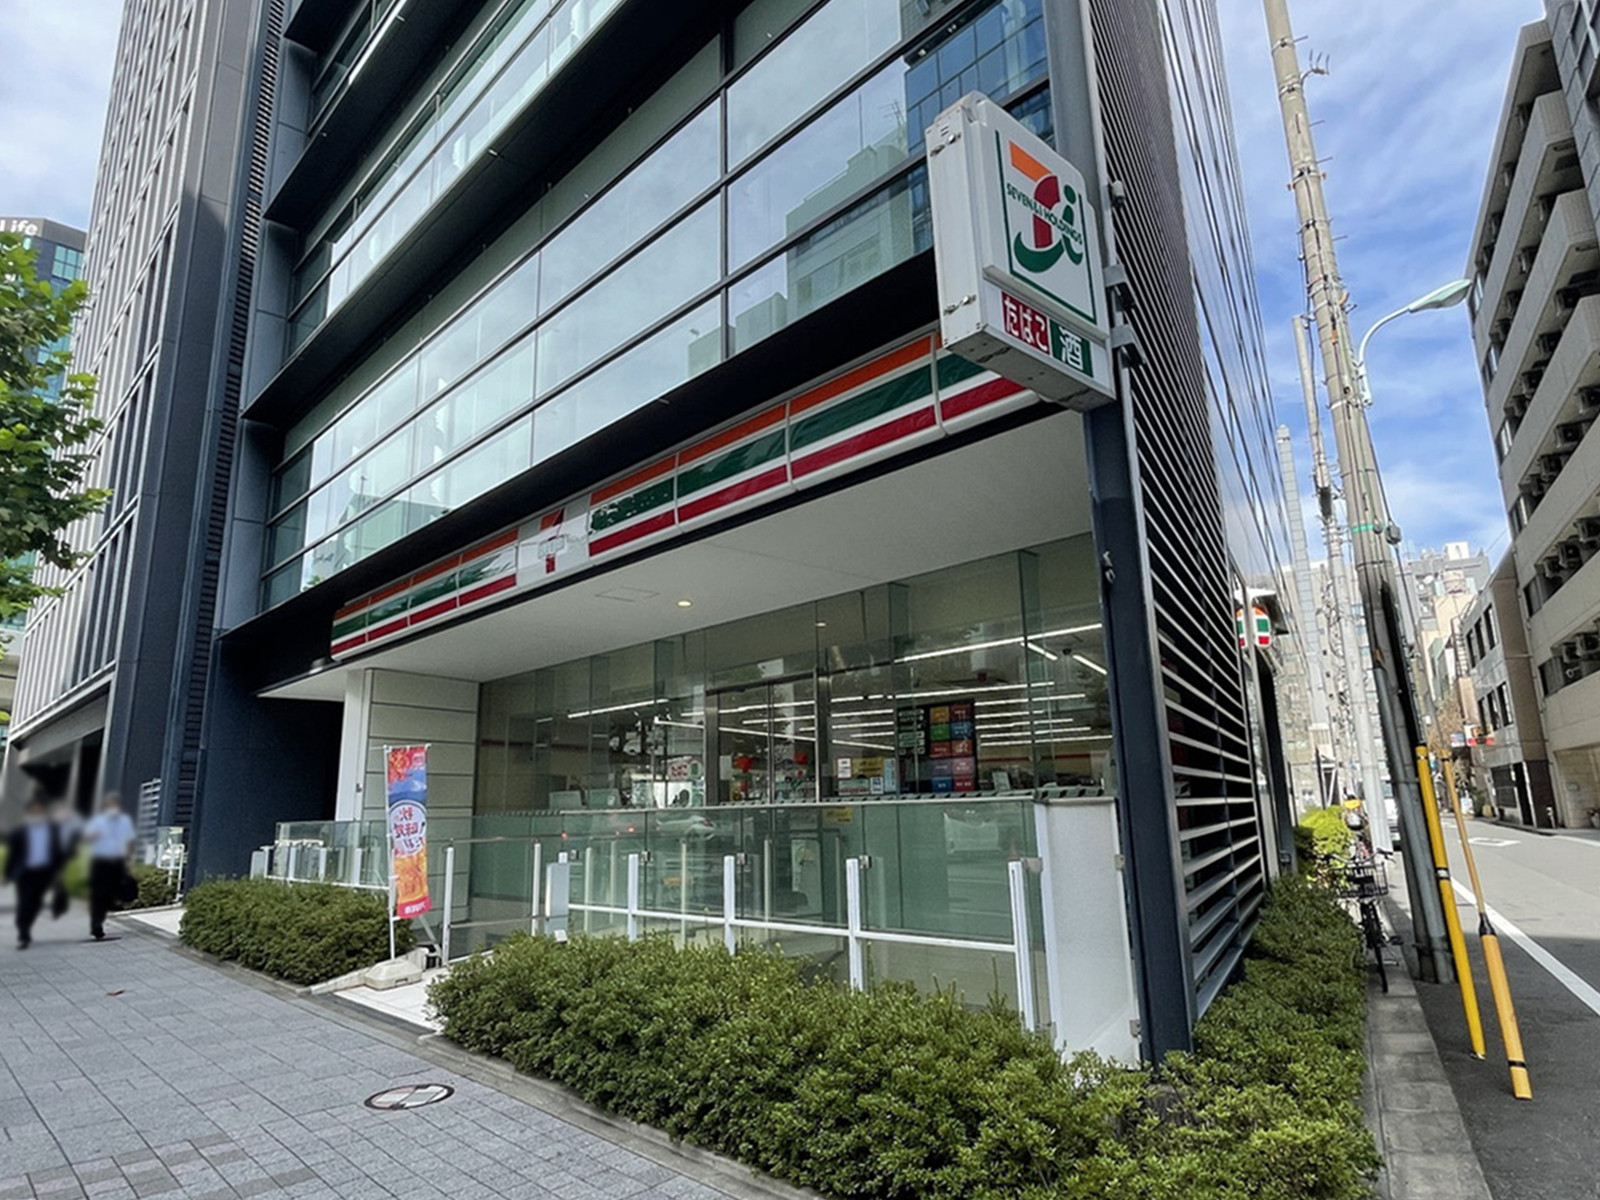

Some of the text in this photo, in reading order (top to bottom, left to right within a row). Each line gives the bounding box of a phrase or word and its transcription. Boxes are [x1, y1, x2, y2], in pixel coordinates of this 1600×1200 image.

[1043, 208, 1083, 246] HOLDINGS
[1004, 296, 1048, 351] たばこ
[1058, 325, 1084, 370] 酒
